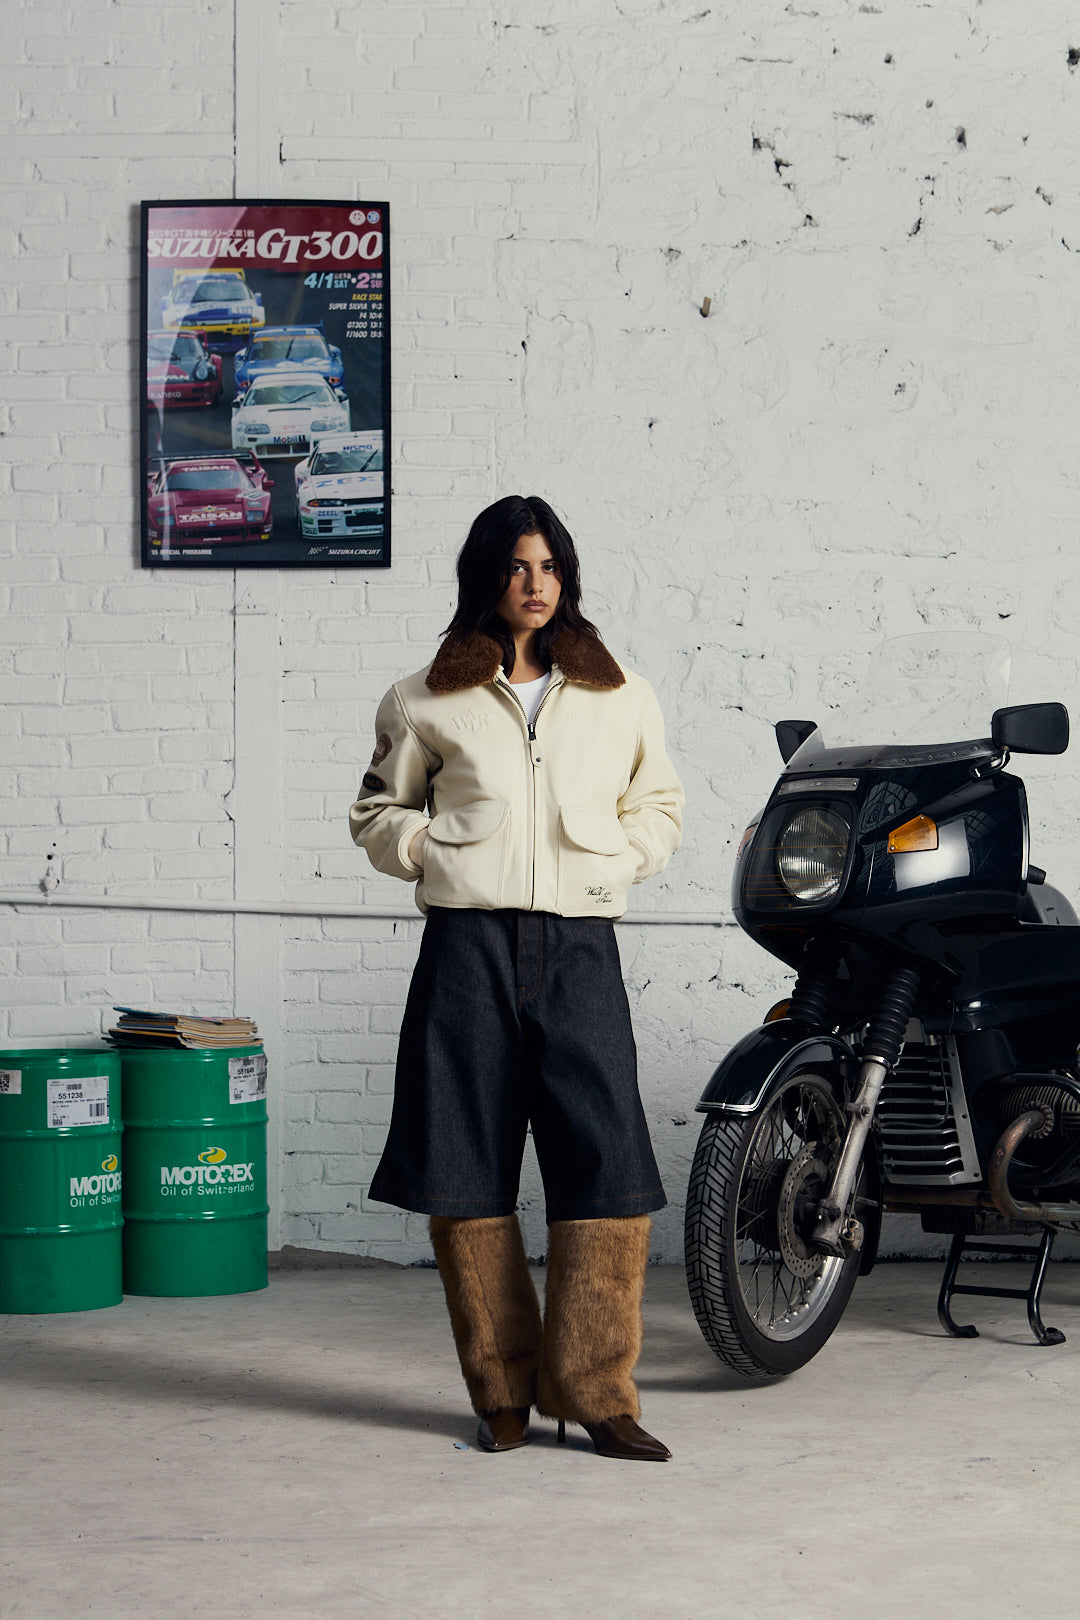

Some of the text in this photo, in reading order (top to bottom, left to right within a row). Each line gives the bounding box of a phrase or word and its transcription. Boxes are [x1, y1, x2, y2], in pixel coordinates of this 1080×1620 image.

[303, 272, 334, 289] 4/1
[333, 280, 348, 289] SAT
[352, 293, 367, 301] RACE
[328, 302, 384, 311] SUPER SILVIA 9:3
[346, 321, 384, 329] GT300 13:1
[345, 330, 368, 339] FJ1600
[273, 435, 298, 444] Mobil
[315, 475, 384, 489] ZEX
[178, 511, 243, 521] TAISAN
[58, 1092, 84, 1100] 551238
[160, 1163, 255, 1185] MOTOREX
[70, 1172, 122, 1196] MOTOR
[160, 1186, 177, 1196] Oil
[181, 1185, 193, 1196] of
[70, 1196, 85, 1208] Oil
[89, 1195, 98, 1206] of
